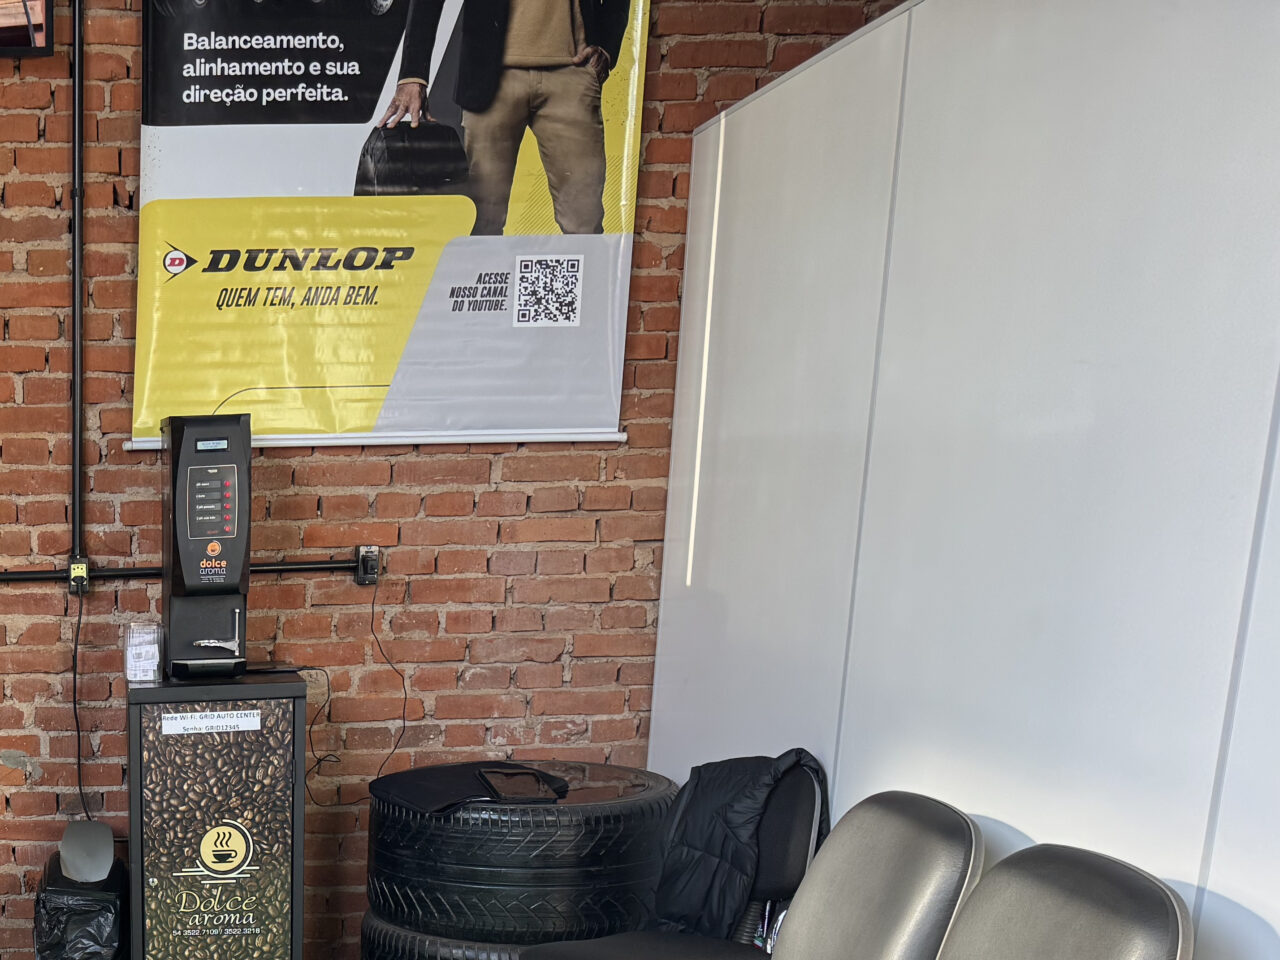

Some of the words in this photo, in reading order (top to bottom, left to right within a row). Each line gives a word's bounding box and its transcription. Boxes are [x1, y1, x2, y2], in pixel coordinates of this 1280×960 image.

[183, 31, 345, 52] Balanceamento,
[182, 57, 305, 77] alinhamento
[309, 61, 321, 76] e
[325, 61, 361, 76] sua
[182, 84, 258, 106] direção
[262, 83, 349, 106] perfeita.
[201, 247, 415, 273] DUNLOP
[475, 272, 511, 285] ACESSE
[216, 287, 261, 311] QUEM
[263, 287, 296, 309] TEM,
[300, 286, 339, 306] ANDA
[343, 285, 379, 306] BEM.
[449, 286, 479, 299] NOSSO
[480, 286, 508, 298] CANAL
[451, 299, 465, 312] DO
[467, 299, 508, 312] YOUTUBE.
[200, 558, 227, 568] dolce
[217, 711, 235, 719] AUTO
[175, 886, 258, 912] Dolce
[188, 912, 257, 926] aroma
